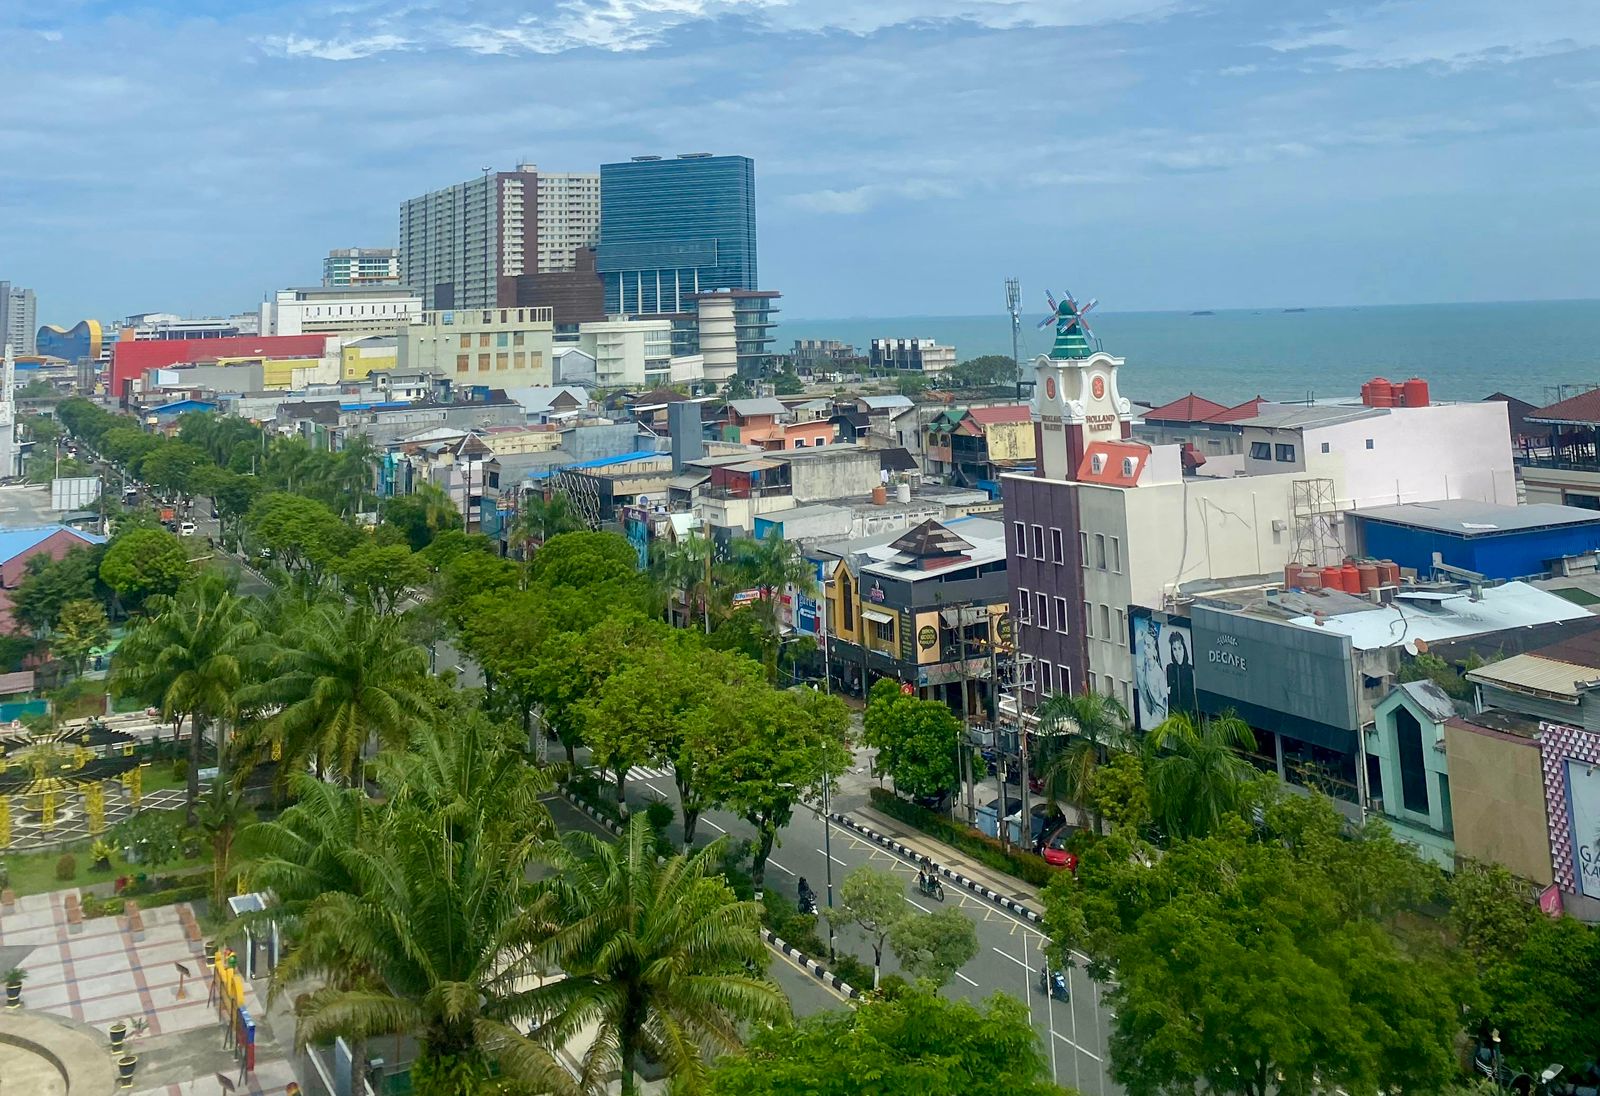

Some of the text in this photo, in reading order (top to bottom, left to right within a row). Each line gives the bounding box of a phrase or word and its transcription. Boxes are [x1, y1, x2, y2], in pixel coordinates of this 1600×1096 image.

[1085, 415, 1115, 423] HOLLAND
[1089, 423, 1113, 432] BAKERY
[1209, 650, 1247, 671] DECAFE
[1582, 861, 1600, 878] KA
